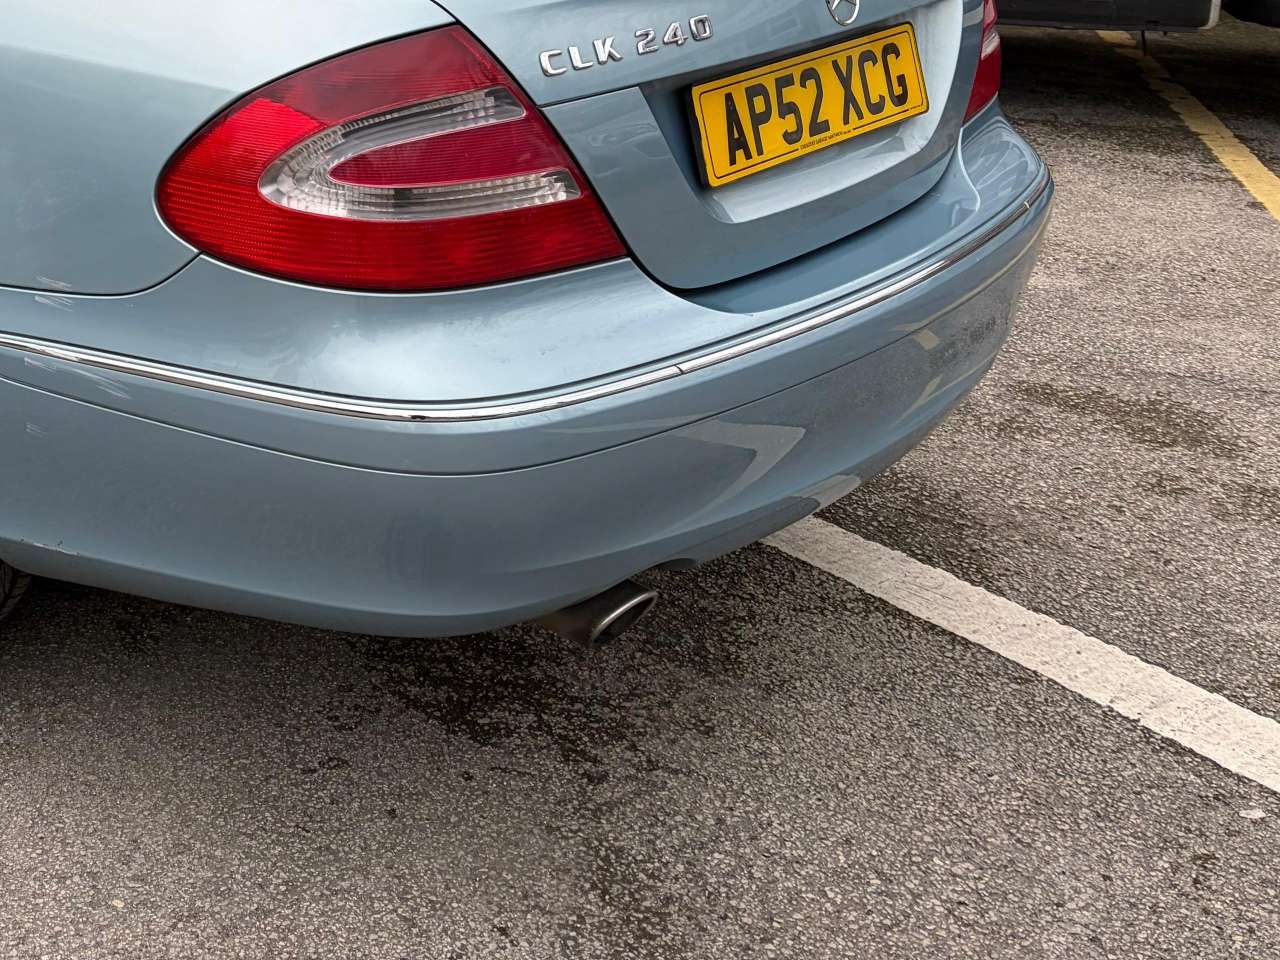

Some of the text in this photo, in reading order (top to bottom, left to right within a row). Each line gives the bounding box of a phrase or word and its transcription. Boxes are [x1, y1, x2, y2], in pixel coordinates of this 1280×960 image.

[539, 14, 712, 77] CLK 240
[728, 42, 909, 168] AP52 XCG
